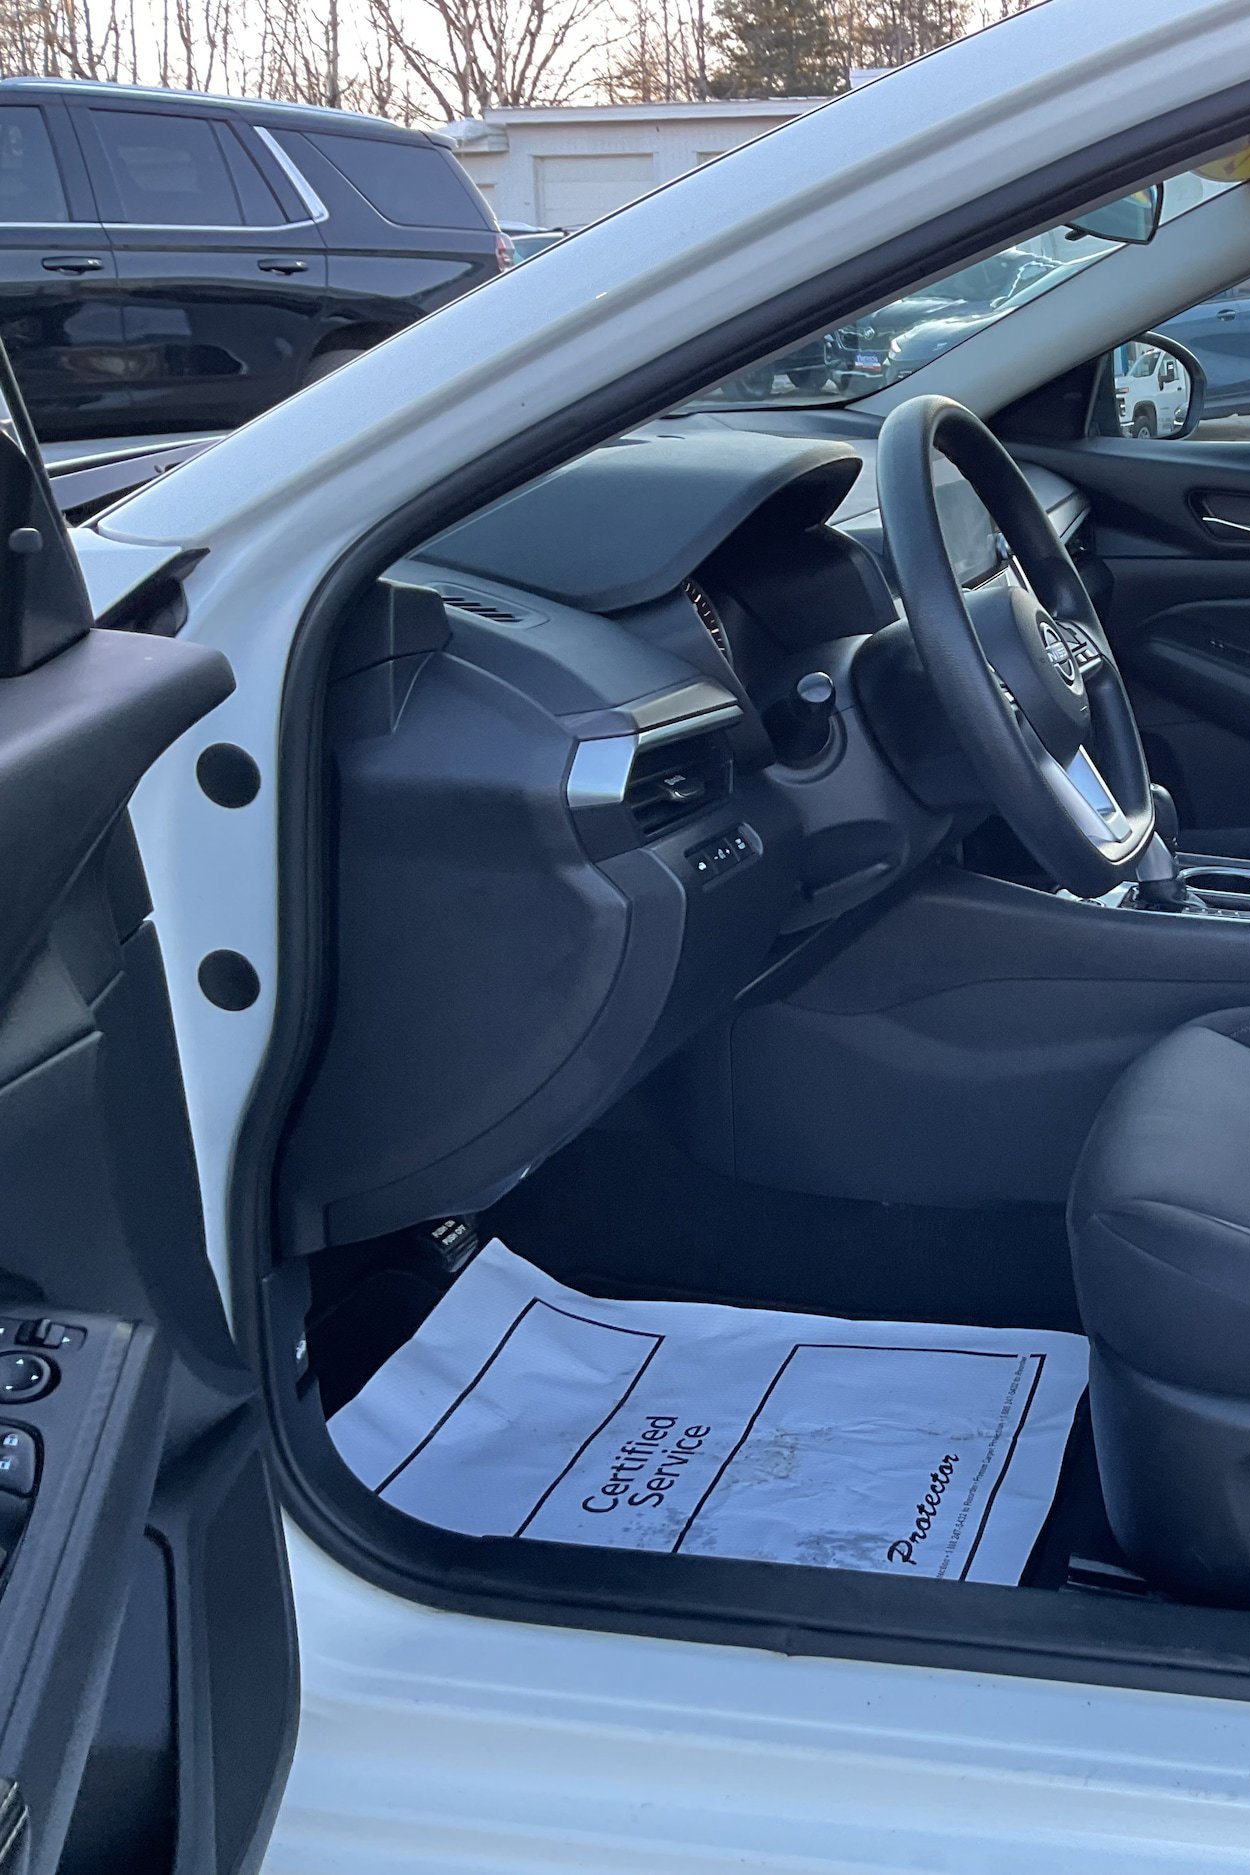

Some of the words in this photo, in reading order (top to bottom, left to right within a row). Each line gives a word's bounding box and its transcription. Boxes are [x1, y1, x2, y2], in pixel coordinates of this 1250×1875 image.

[432, 1225, 448, 1238] PUSH
[442, 1232, 458, 1245] PUSH
[455, 1224, 466, 1234] OFF
[582, 1416, 679, 1513] Certified
[627, 1425, 711, 1507] Service
[887, 1454, 959, 1565] Protector
